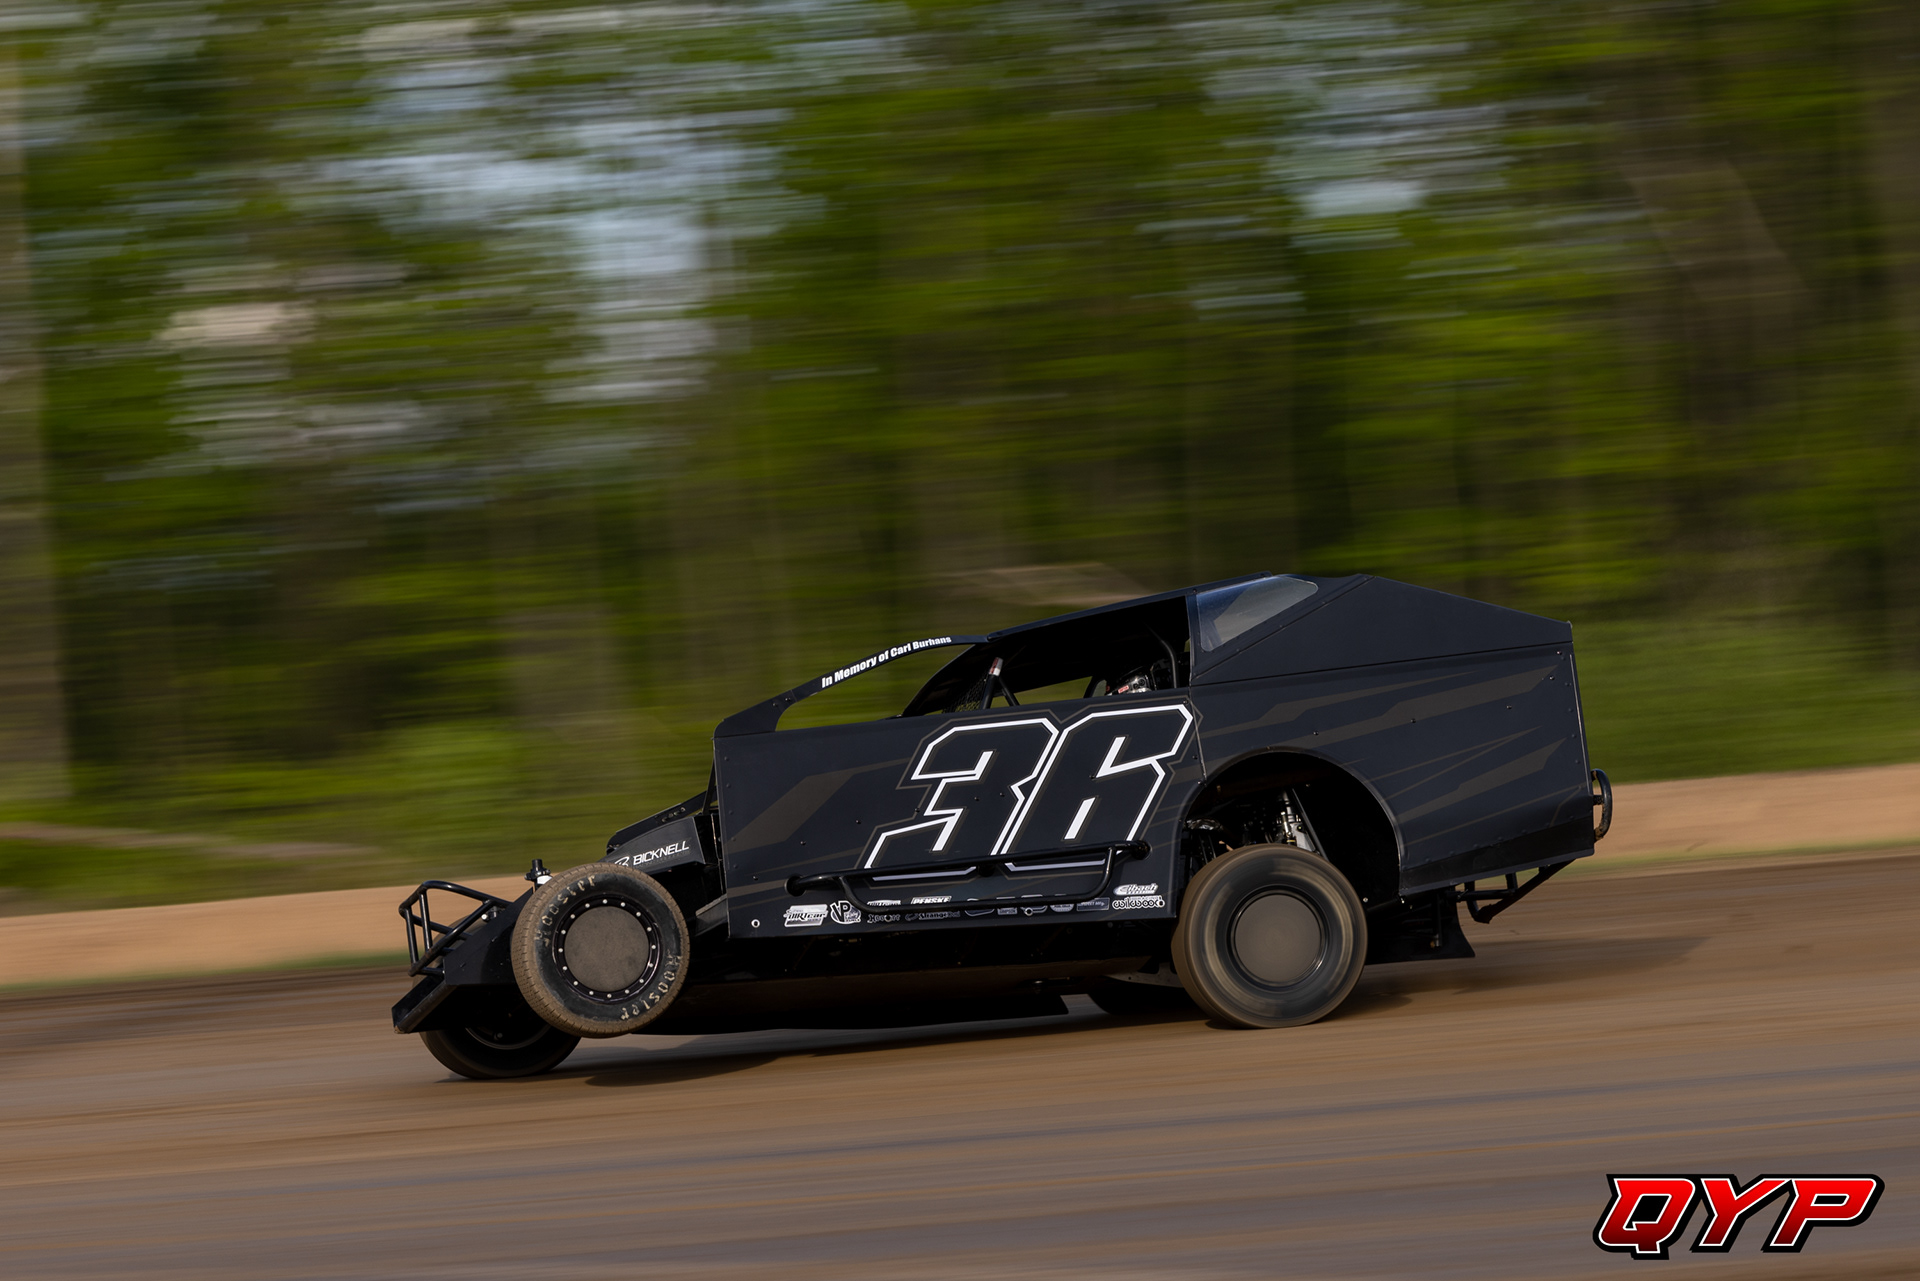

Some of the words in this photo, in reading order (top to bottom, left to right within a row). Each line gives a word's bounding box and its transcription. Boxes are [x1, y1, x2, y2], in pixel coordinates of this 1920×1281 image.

[821, 676, 833, 688] In
[834, 656, 877, 682] Memory
[878, 650, 890, 663] of
[890, 643, 912, 657] Carl
[912, 636, 952, 650] Burhans
[865, 704, 1193, 881] 36
[633, 841, 690, 866] BICKNELL
[831, 901, 851, 922] VP
